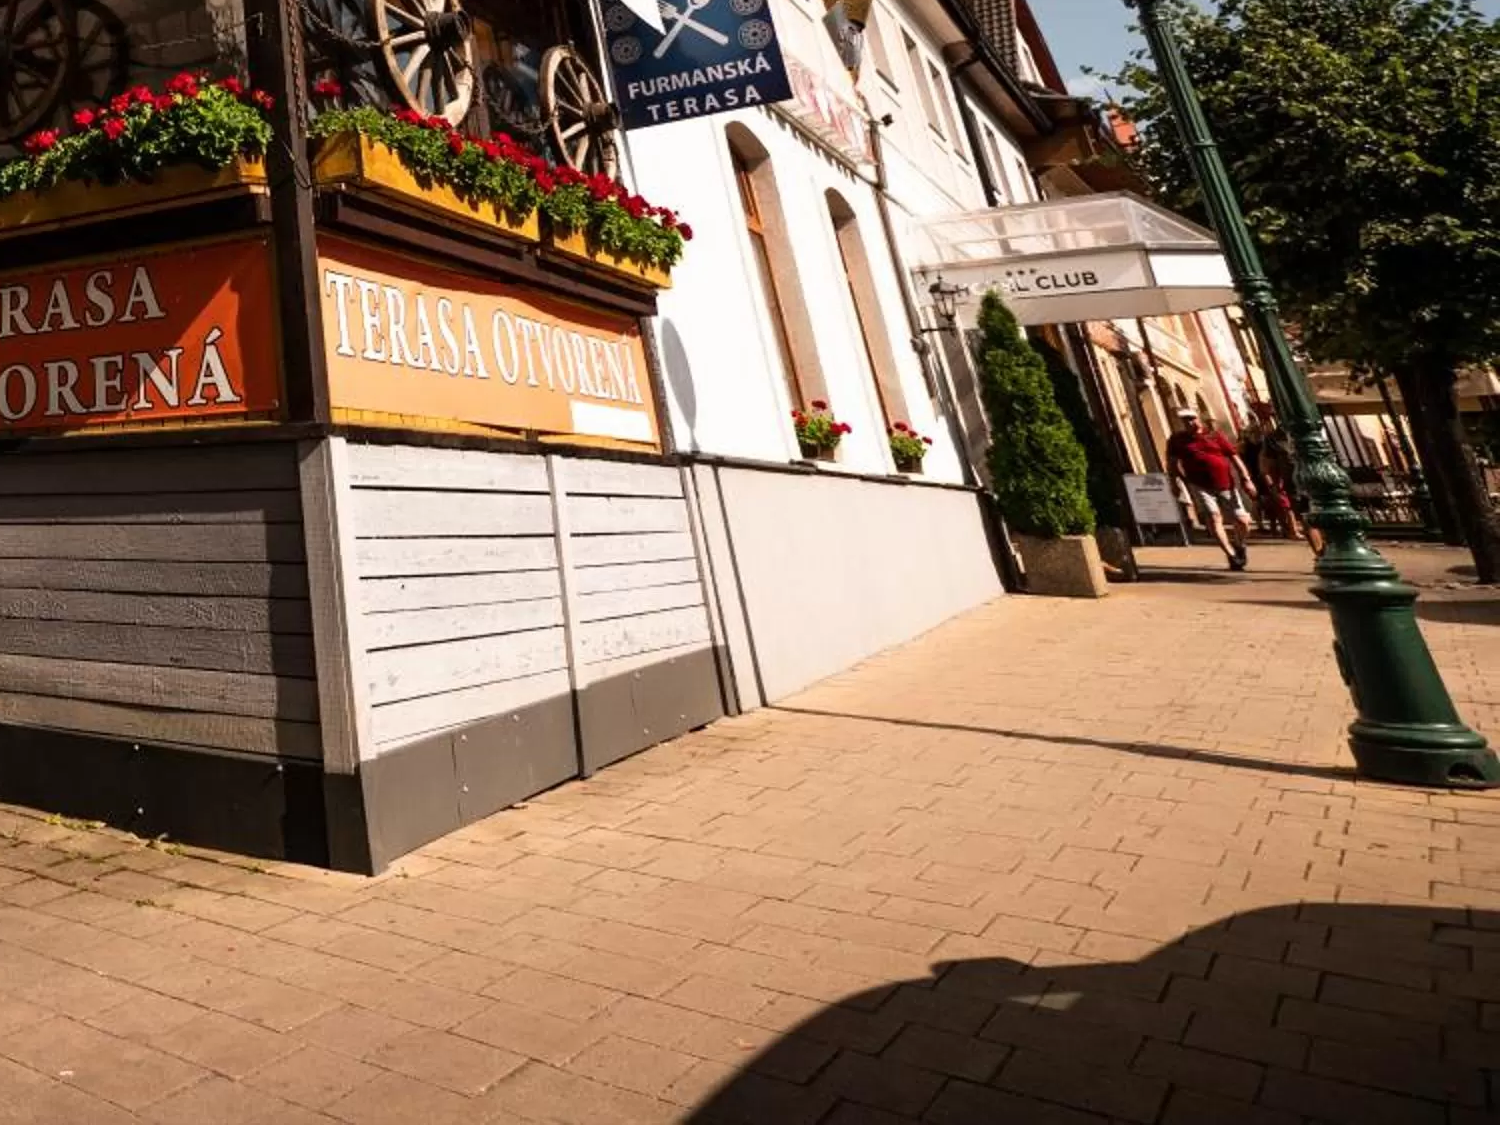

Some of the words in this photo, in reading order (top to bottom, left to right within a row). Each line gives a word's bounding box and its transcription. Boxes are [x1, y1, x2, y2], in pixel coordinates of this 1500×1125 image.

[627, 51, 772, 100] FURMANSKÁ
[646, 84, 762, 122] TERASA
[1034, 271, 1099, 290] CLUB
[324, 268, 490, 379] TERASA
